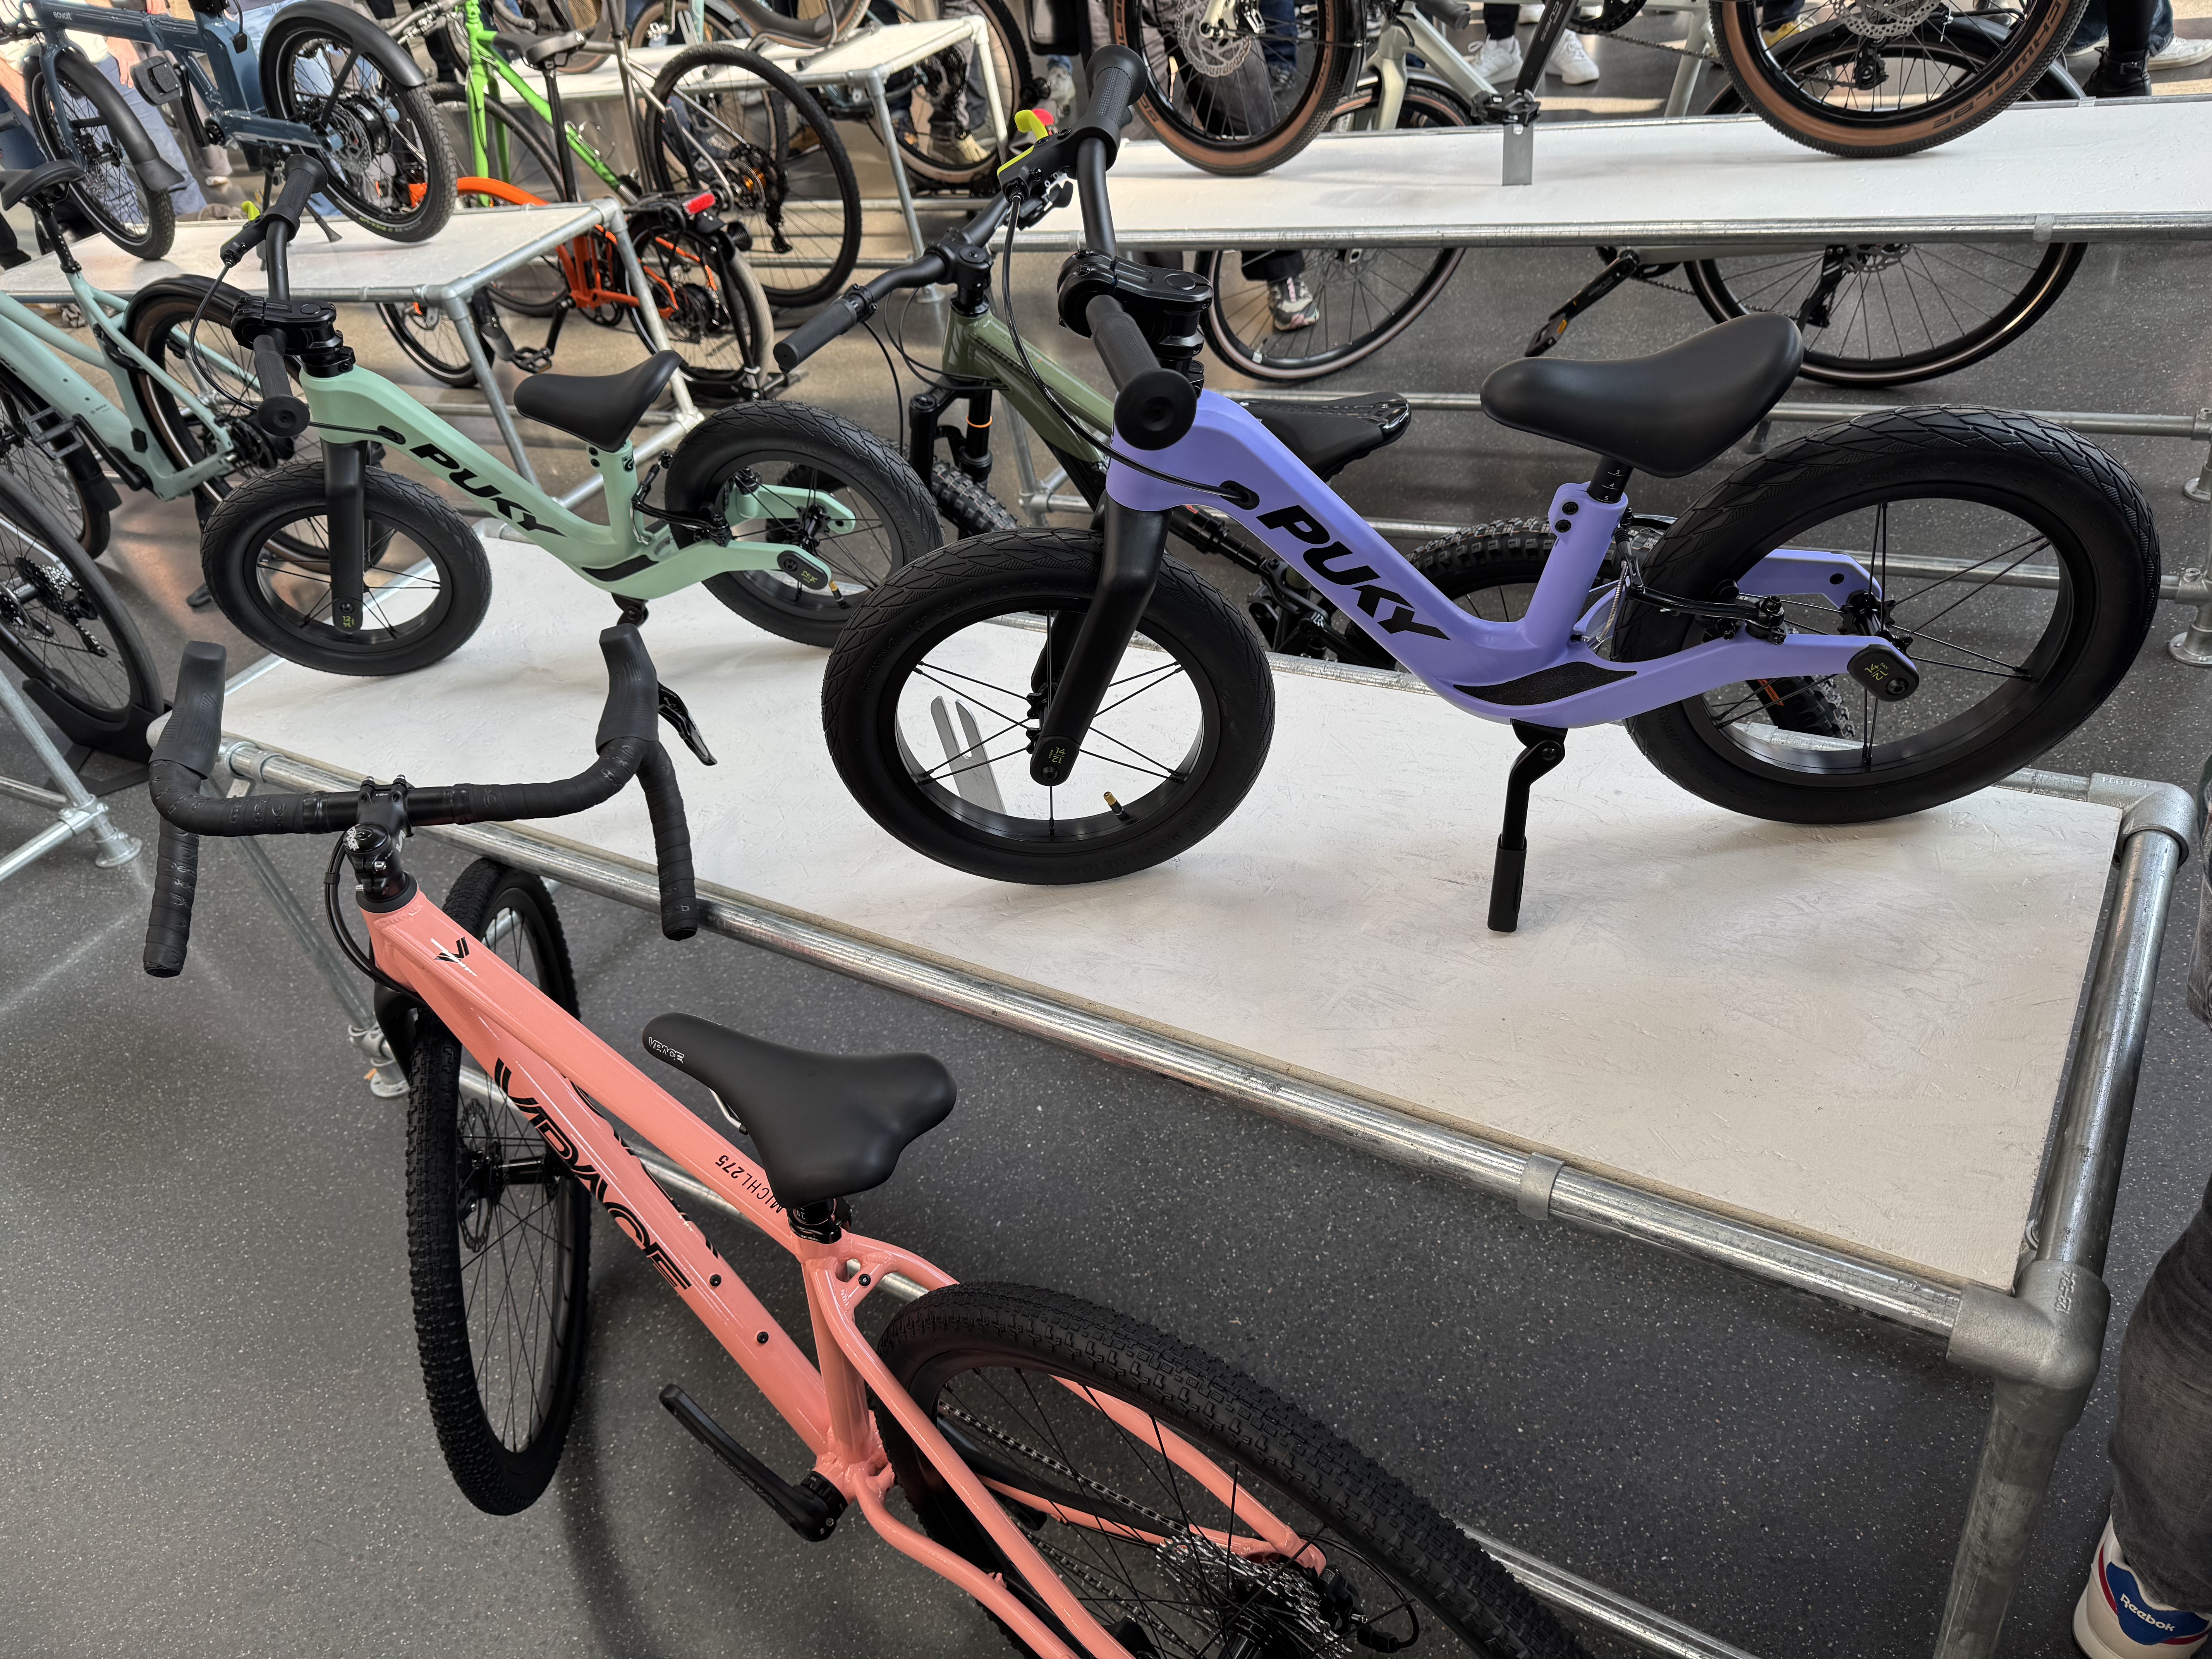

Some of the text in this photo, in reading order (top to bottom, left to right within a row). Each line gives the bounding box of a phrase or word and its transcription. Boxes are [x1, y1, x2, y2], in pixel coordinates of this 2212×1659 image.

[1932, 0, 2064, 129] CHWALBE
[409, 443, 568, 538] PUKY
[1256, 505, 1451, 641] PUKY
[649, 1036, 684, 1064] VPACE
[494, 1057, 692, 1290] VPACE
[715, 1155, 745, 1179] 275
[2120, 1593, 2176, 1632] Reebok
